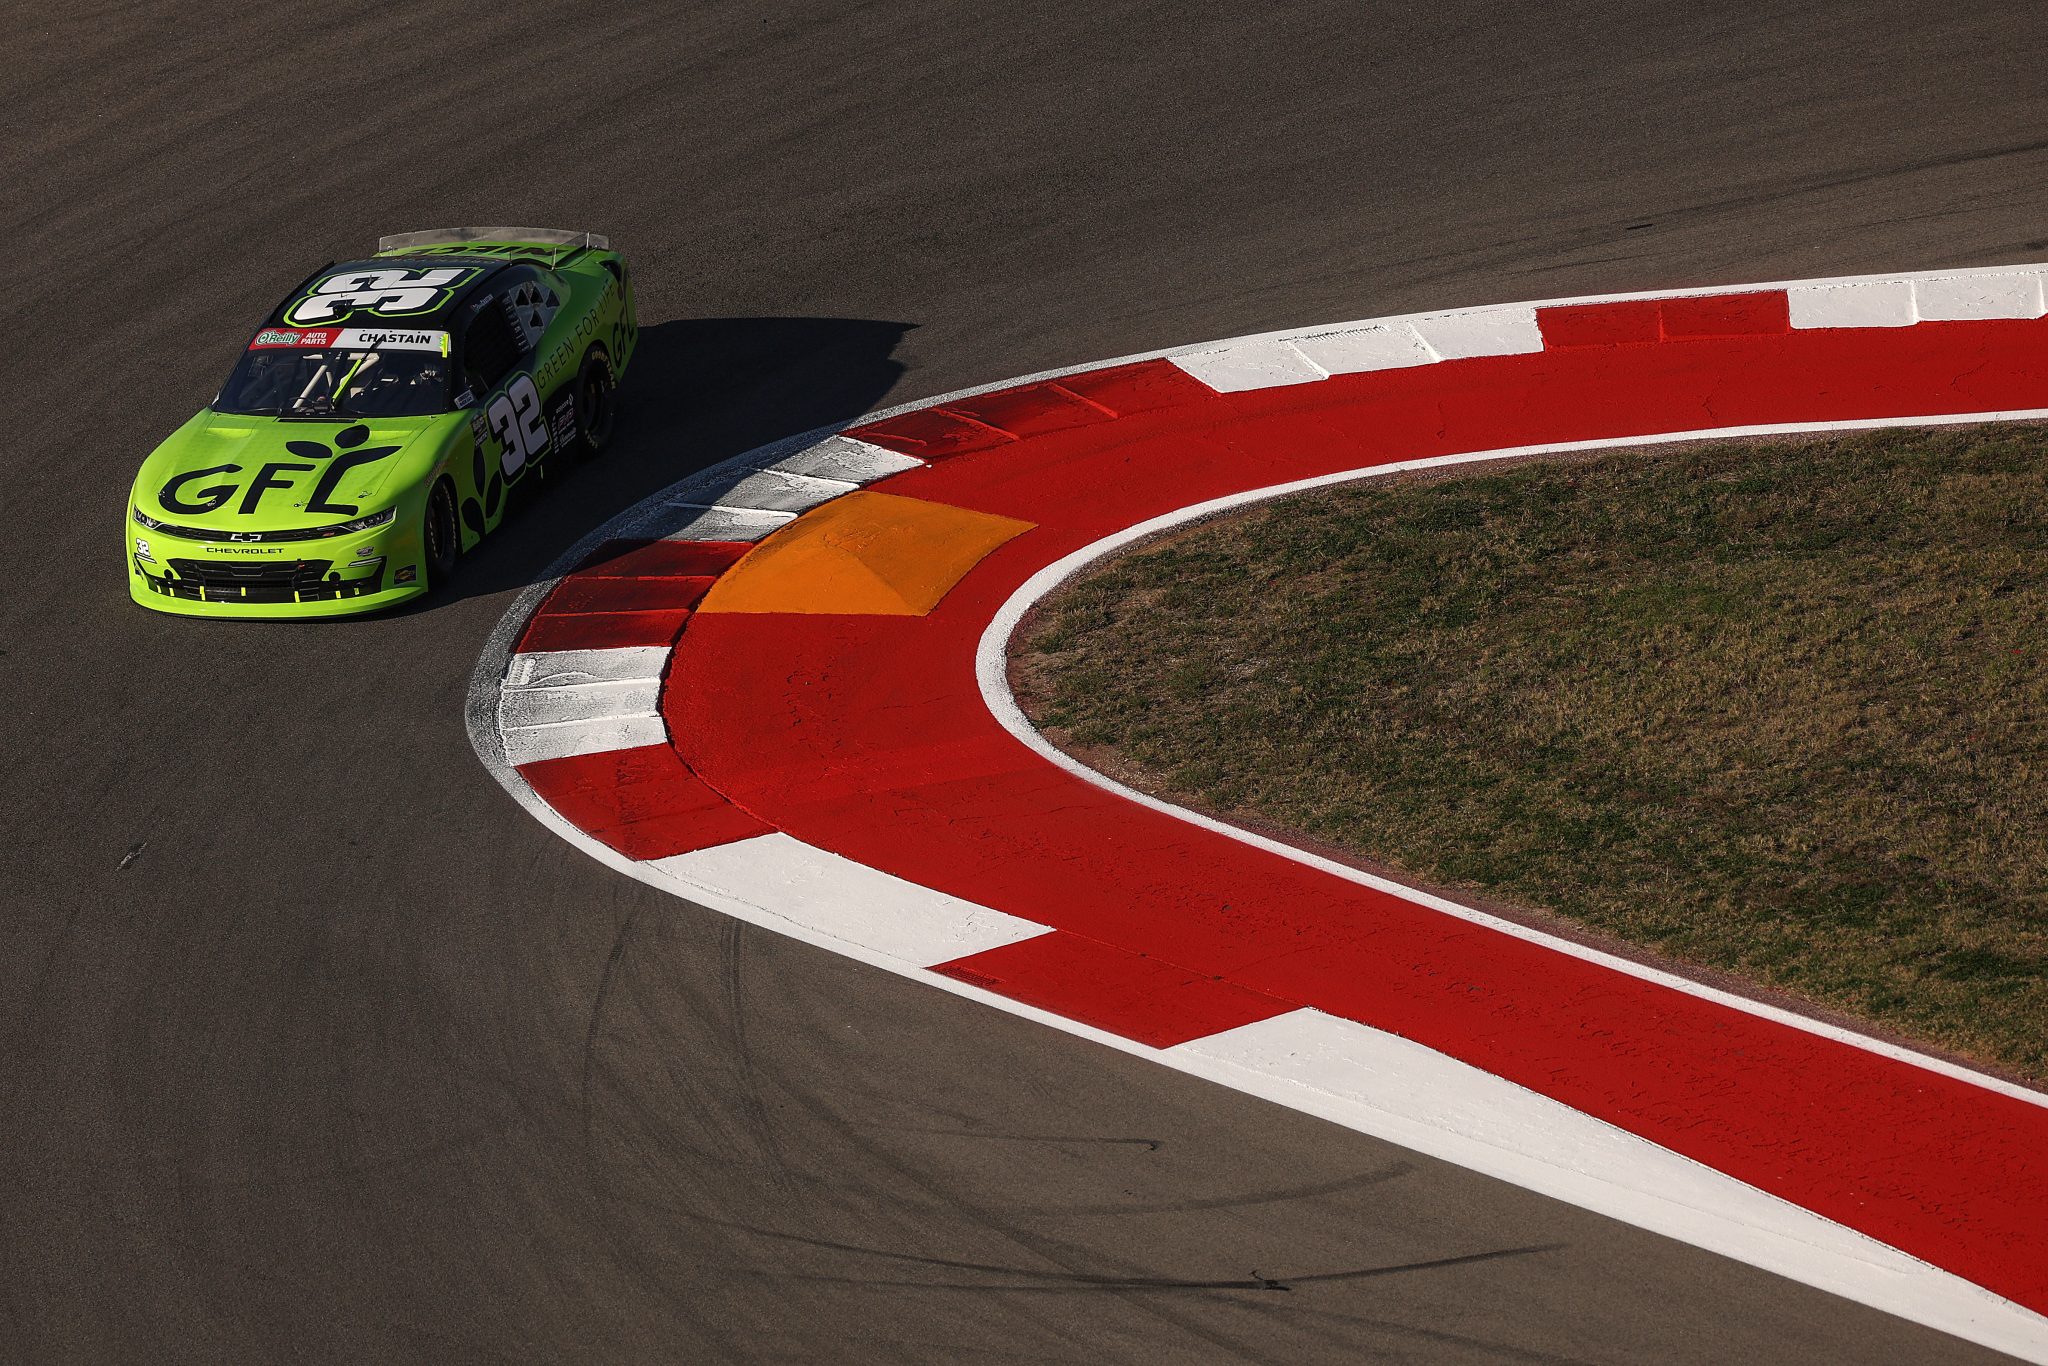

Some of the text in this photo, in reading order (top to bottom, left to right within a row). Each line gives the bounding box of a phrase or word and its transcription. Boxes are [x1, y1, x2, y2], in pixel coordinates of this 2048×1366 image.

[293, 268, 466, 321] 32
[256, 330, 302, 346] O'Reilly
[300, 337, 327, 346] PARTS
[305, 331, 327, 340] AUTO
[358, 333, 432, 345] CHASTAIN
[536, 336, 575, 389] GREEN
[574, 308, 600, 345] FOR
[598, 278, 616, 315] LIFE
[487, 374, 549, 477] 32
[157, 445, 403, 517] GFL
[135, 537, 152, 557] 32
[205, 546, 285, 555] CHEVROLET
